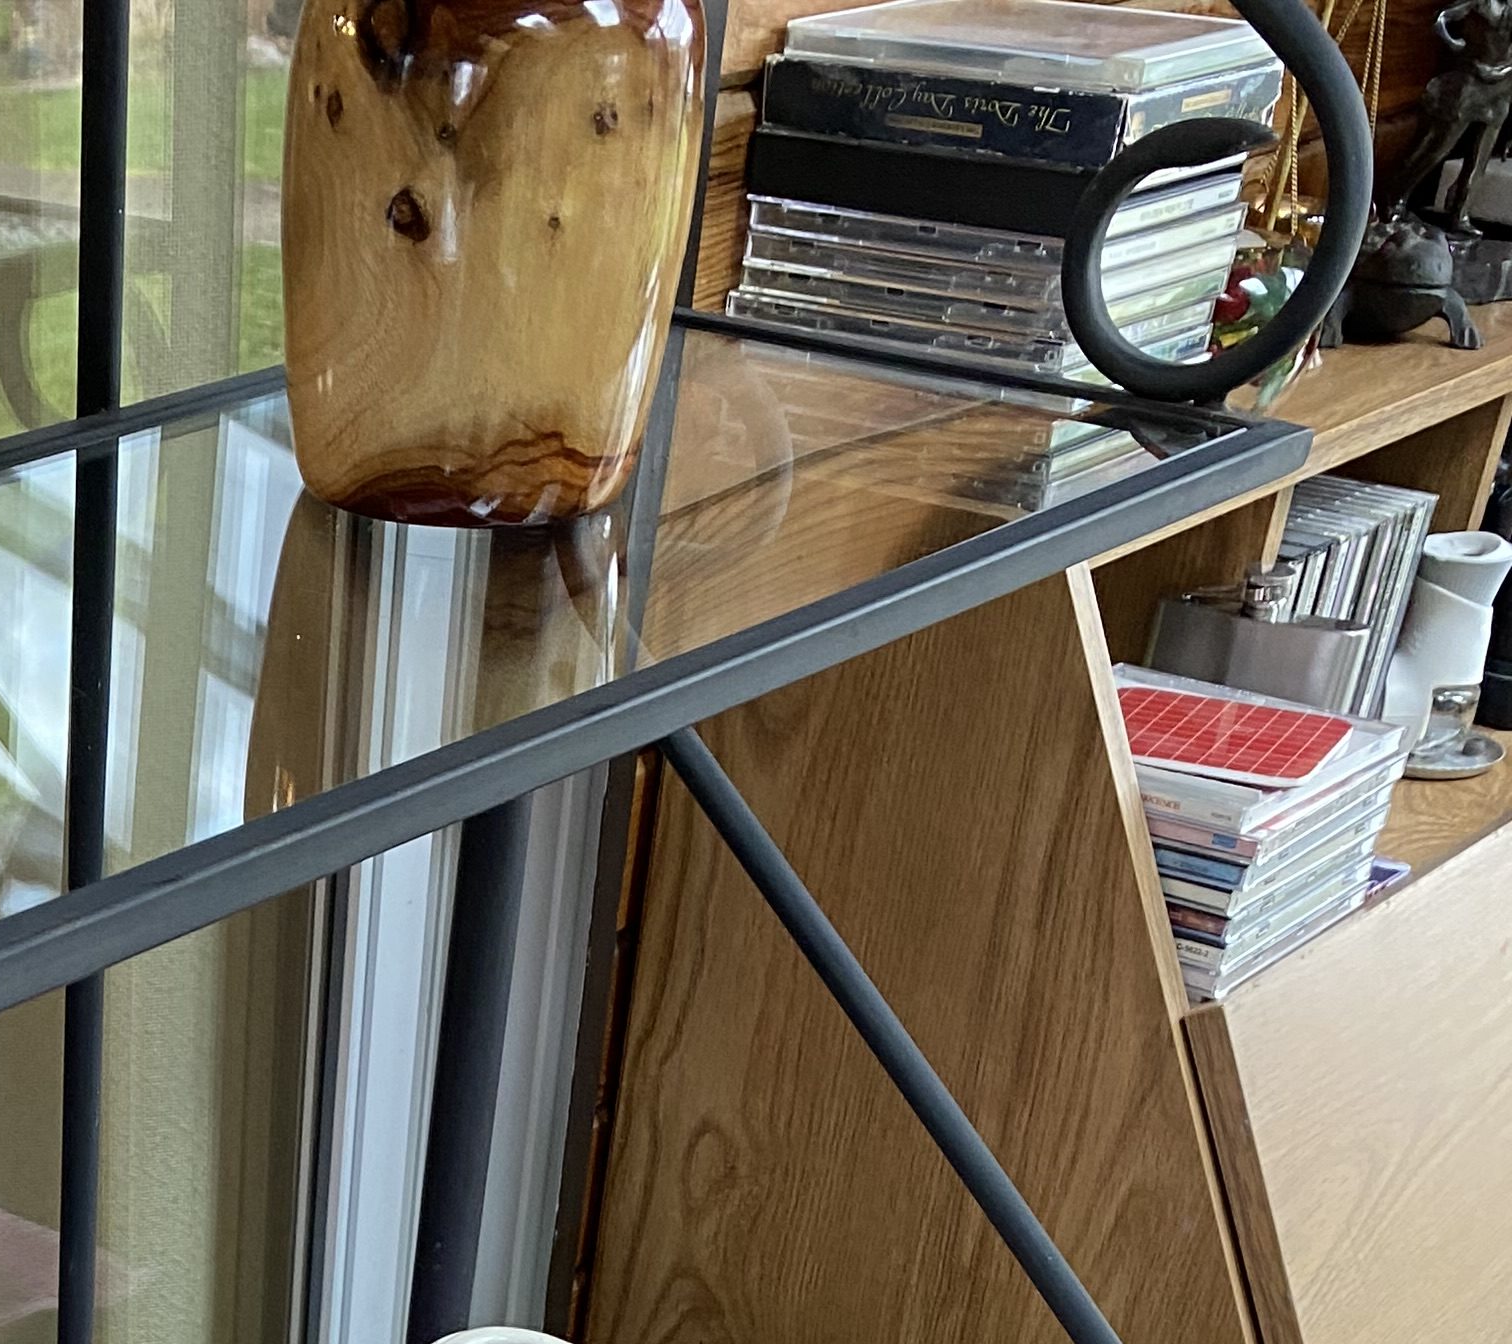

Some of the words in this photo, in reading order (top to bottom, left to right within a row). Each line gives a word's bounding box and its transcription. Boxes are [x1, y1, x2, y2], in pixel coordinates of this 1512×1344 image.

[812, 78, 907, 110] Collection
[912, 81, 957, 118] Day
[964, 96, 1022, 127] Doris
[1027, 105, 1071, 132] The
